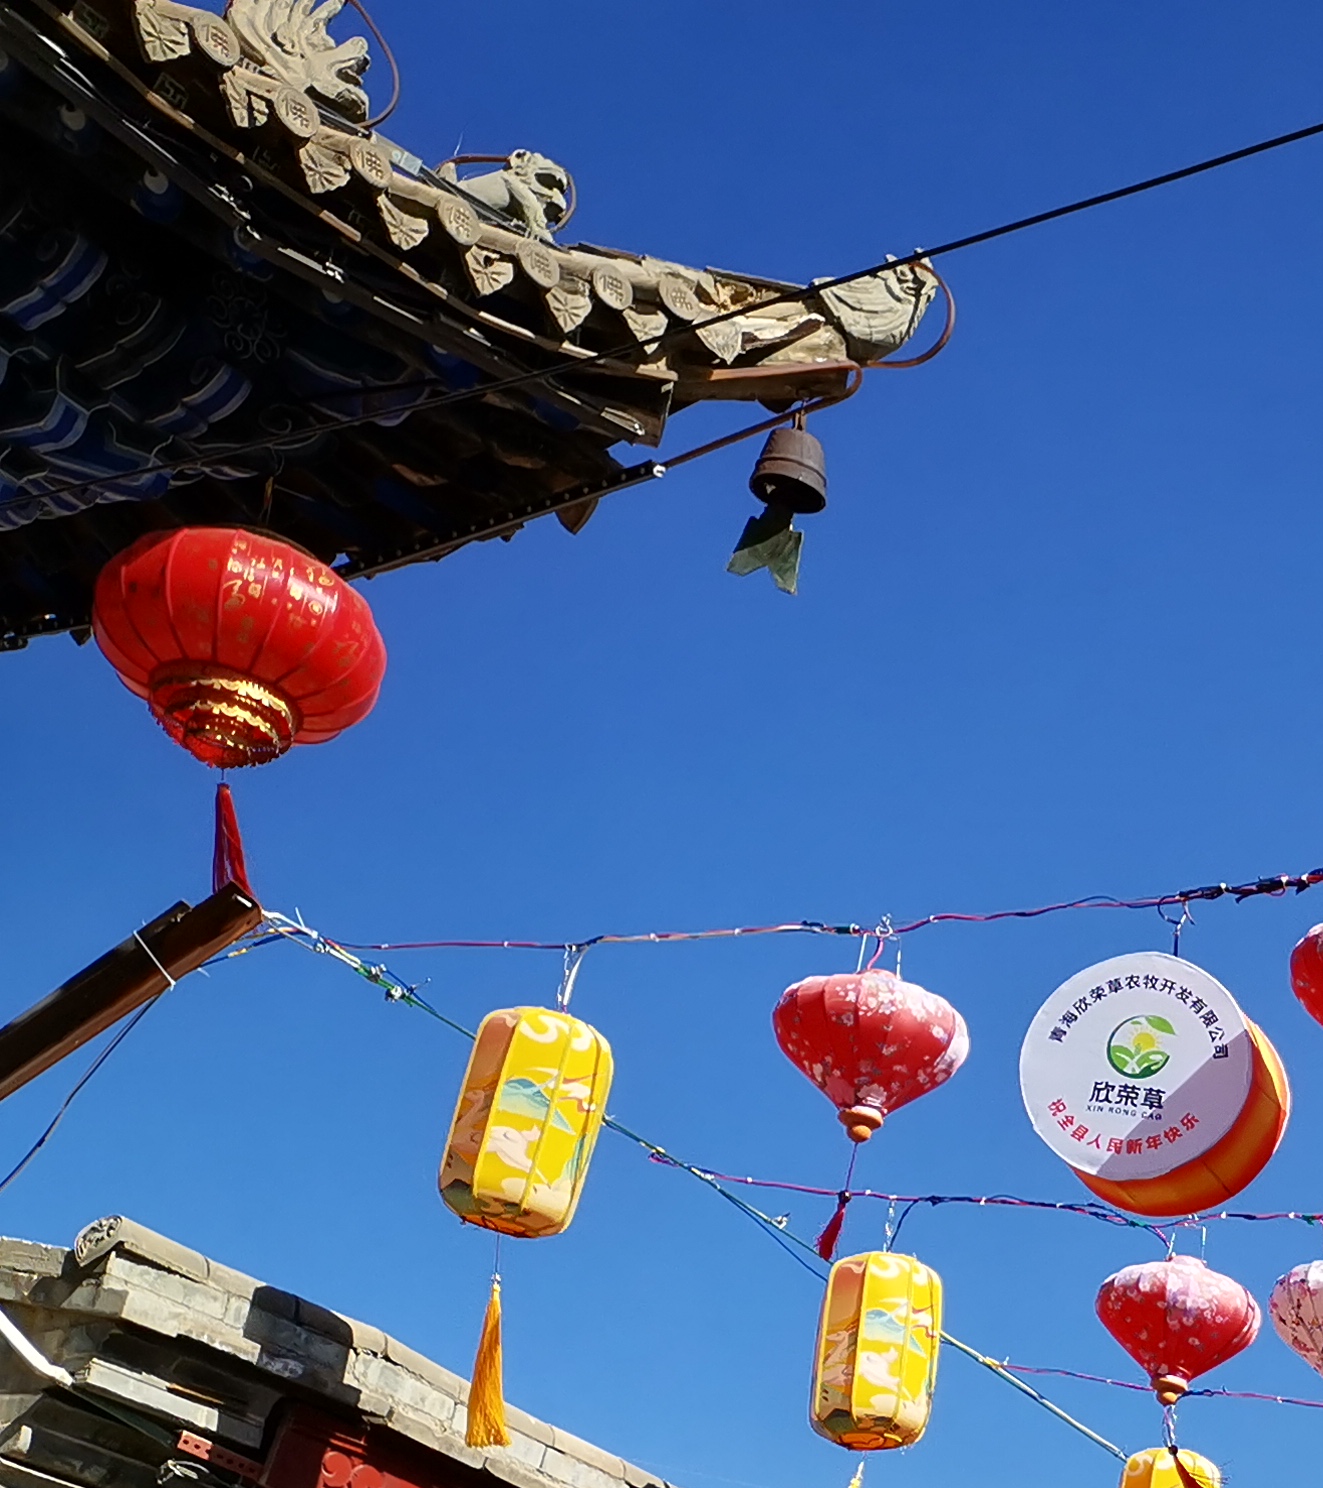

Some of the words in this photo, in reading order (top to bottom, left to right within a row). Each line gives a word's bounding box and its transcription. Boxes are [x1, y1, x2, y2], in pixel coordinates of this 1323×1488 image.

[1048, 974, 1228, 1060] 青海欣荣草农牧开发有限公司
[1088, 1081, 1166, 1110] 欣荣草
[1108, 1106, 1137, 1117] RONG
[1047, 1098, 1201, 1155] 祝全县人民新年快乐
